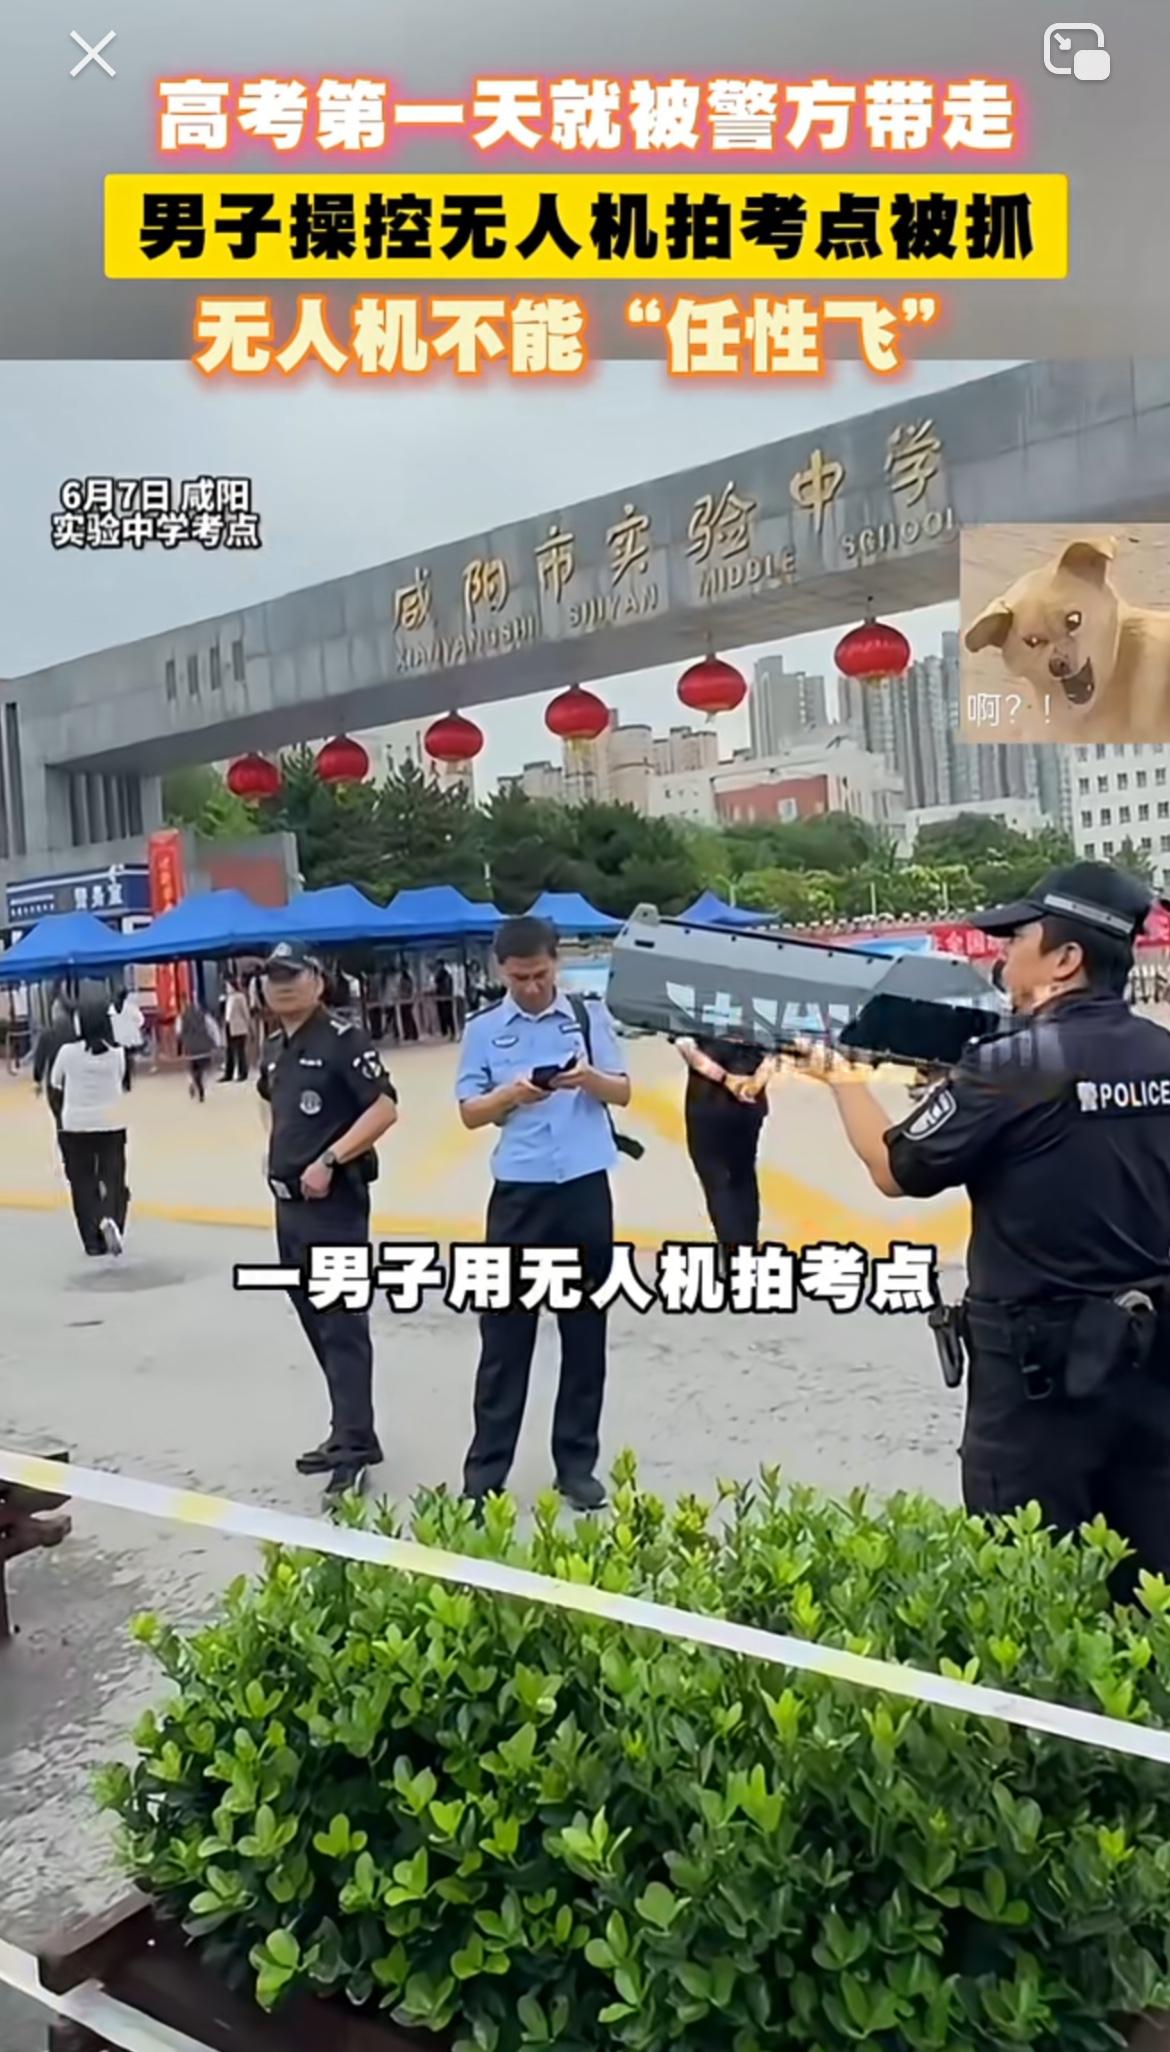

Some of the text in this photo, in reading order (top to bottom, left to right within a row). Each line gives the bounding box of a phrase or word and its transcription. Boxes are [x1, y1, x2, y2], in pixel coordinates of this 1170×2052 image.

[394, 417, 942, 633] 咸阳市实验中学
